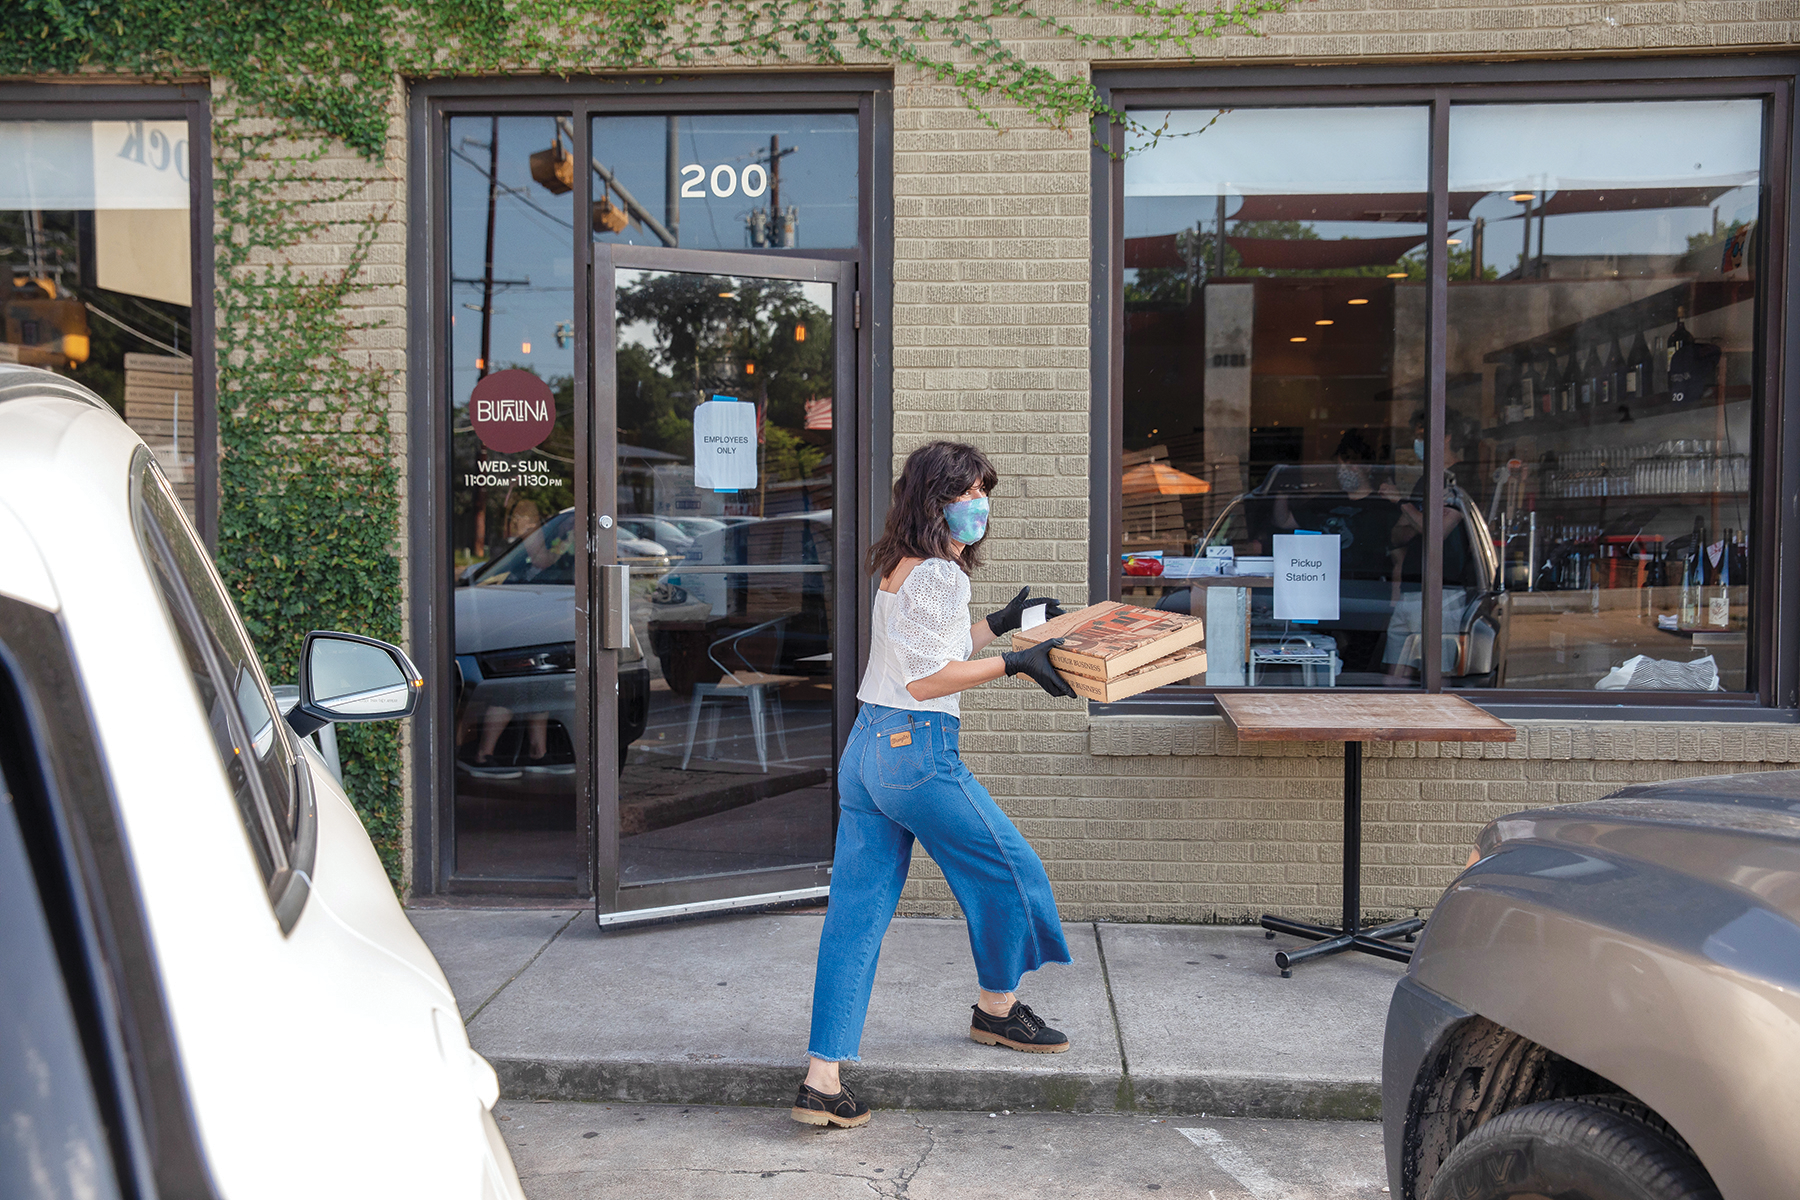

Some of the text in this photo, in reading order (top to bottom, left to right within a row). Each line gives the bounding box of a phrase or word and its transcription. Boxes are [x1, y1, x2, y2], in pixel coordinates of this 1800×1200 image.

[680, 164, 767, 198] 200
[477, 400, 549, 422] BUFALINA
[703, 435, 749, 444] EMPLOYEES
[716, 446, 737, 455] ONLY
[1291, 558, 1322, 569] Pickup
[1285, 572, 1326, 582] Station 1
[1056, 655, 1073, 666] YOUR
[1073, 659, 1101, 672] BUSINESS
[1075, 681, 1102, 695] BUSINESS
